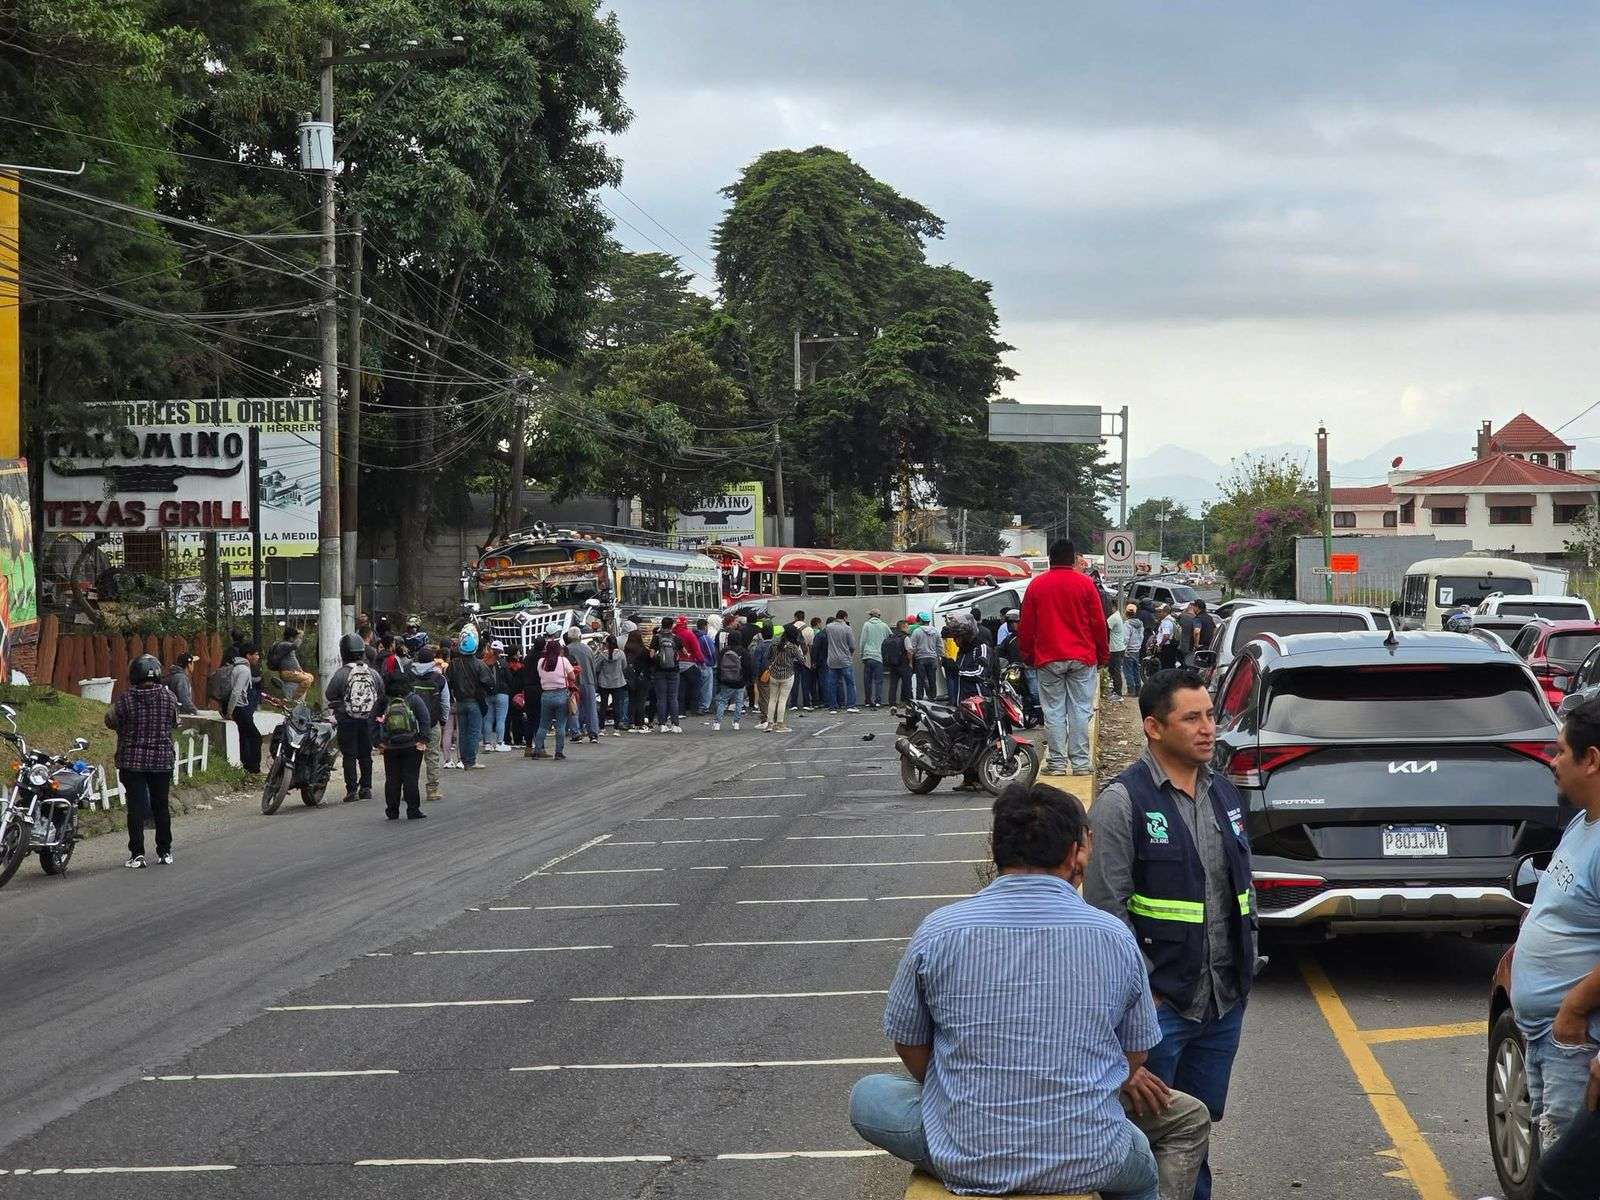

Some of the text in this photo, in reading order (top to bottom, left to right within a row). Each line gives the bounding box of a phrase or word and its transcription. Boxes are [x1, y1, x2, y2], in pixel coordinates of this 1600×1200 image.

[43, 500, 250, 528] TEXAS GRILL
[221, 533, 250, 542] TEJA
[264, 532, 278, 540] LA
[282, 532, 318, 540] MEDID
[197, 546, 278, 558] DMICIIO
[1443, 589, 1452, 602] 7
[1388, 761, 1438, 774] KIA
